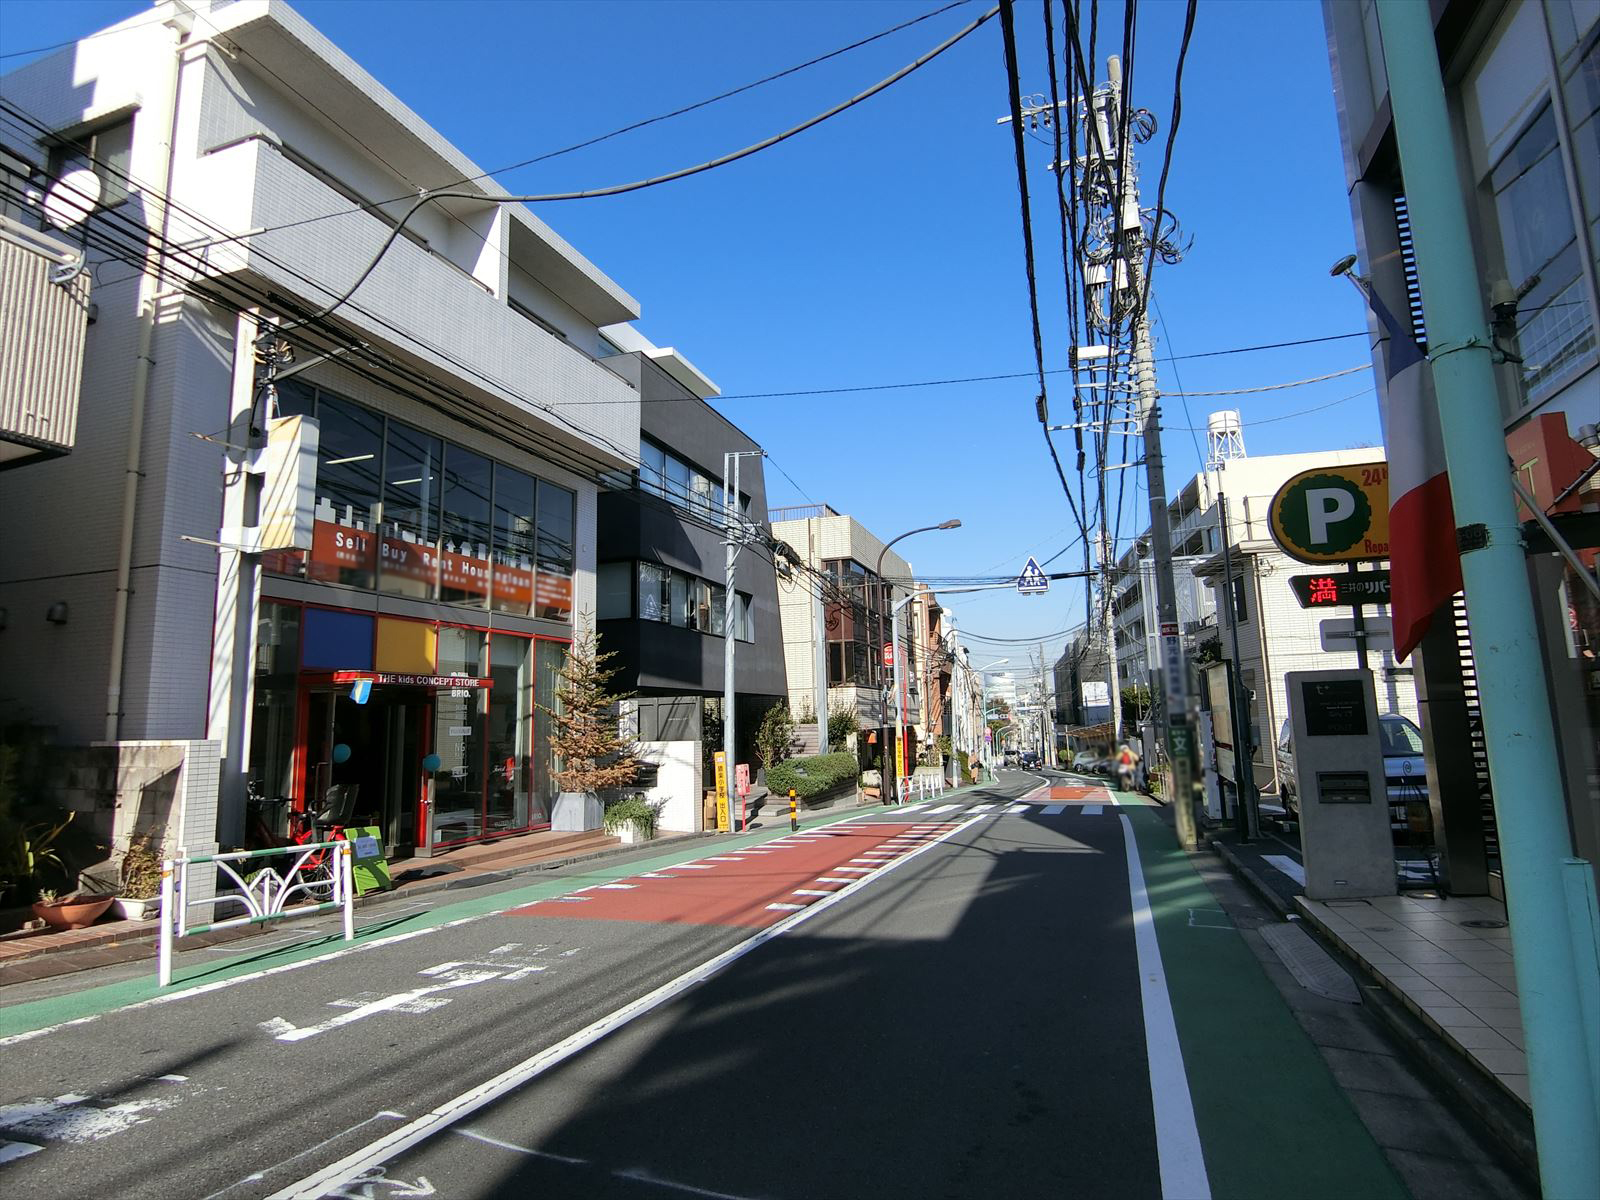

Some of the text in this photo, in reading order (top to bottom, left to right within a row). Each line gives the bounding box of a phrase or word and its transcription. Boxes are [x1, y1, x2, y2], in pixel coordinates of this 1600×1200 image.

[1305, 487, 1355, 545] P
[336, 532, 366, 551] Sell
[382, 543, 408, 563] Buy
[422, 552, 453, 572] Rent
[1309, 578, 1337, 603] 満
[377, 673, 480, 687] THE kids CONCEPT STORE
